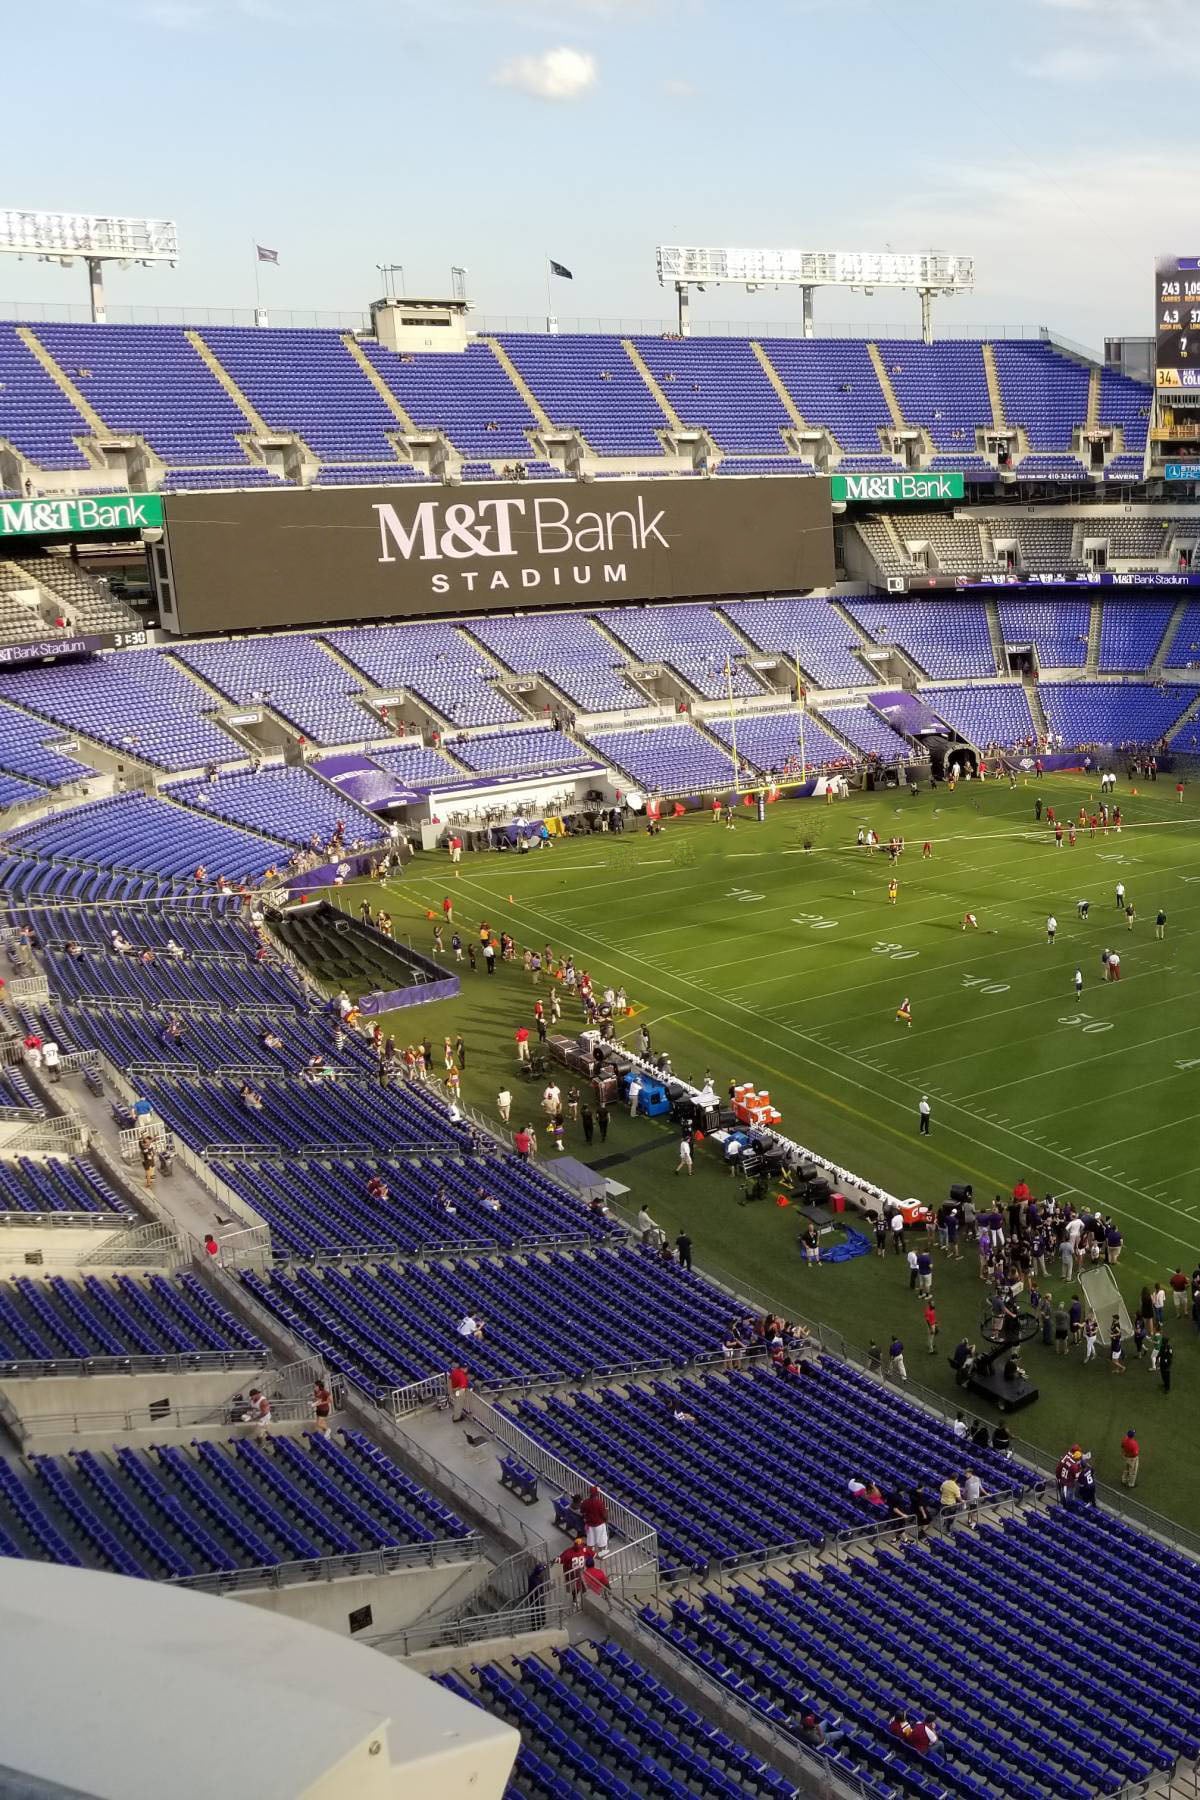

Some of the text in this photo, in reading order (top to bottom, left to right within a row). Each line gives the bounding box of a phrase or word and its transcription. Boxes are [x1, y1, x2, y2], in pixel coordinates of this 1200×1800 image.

[1162, 282, 1180, 295] 243
[1163, 310, 1179, 323] 4.3
[1180, 337, 1187, 350] 7
[1159, 371, 1171, 384] 34
[845, 473, 953, 499] M&T Bank
[0, 497, 148, 533] M&T Bank
[371, 493, 671, 563] M&T Bank
[431, 562, 629, 594] STADIUM
[1112, 574, 1133, 585] M&T
[1134, 574, 1155, 585] Bank
[1155, 574, 1189, 585] Stadium
[14, 646, 40, 660] Bank
[40, 640, 86, 657] Stadium
[724, 889, 766, 901] 10
[790, 914, 839, 929] 20
[871, 941, 920, 960] 30
[959, 974, 1011, 994] 40
[1057, 1012, 1115, 1034] 50
[571, 1556, 585, 1568] 28
